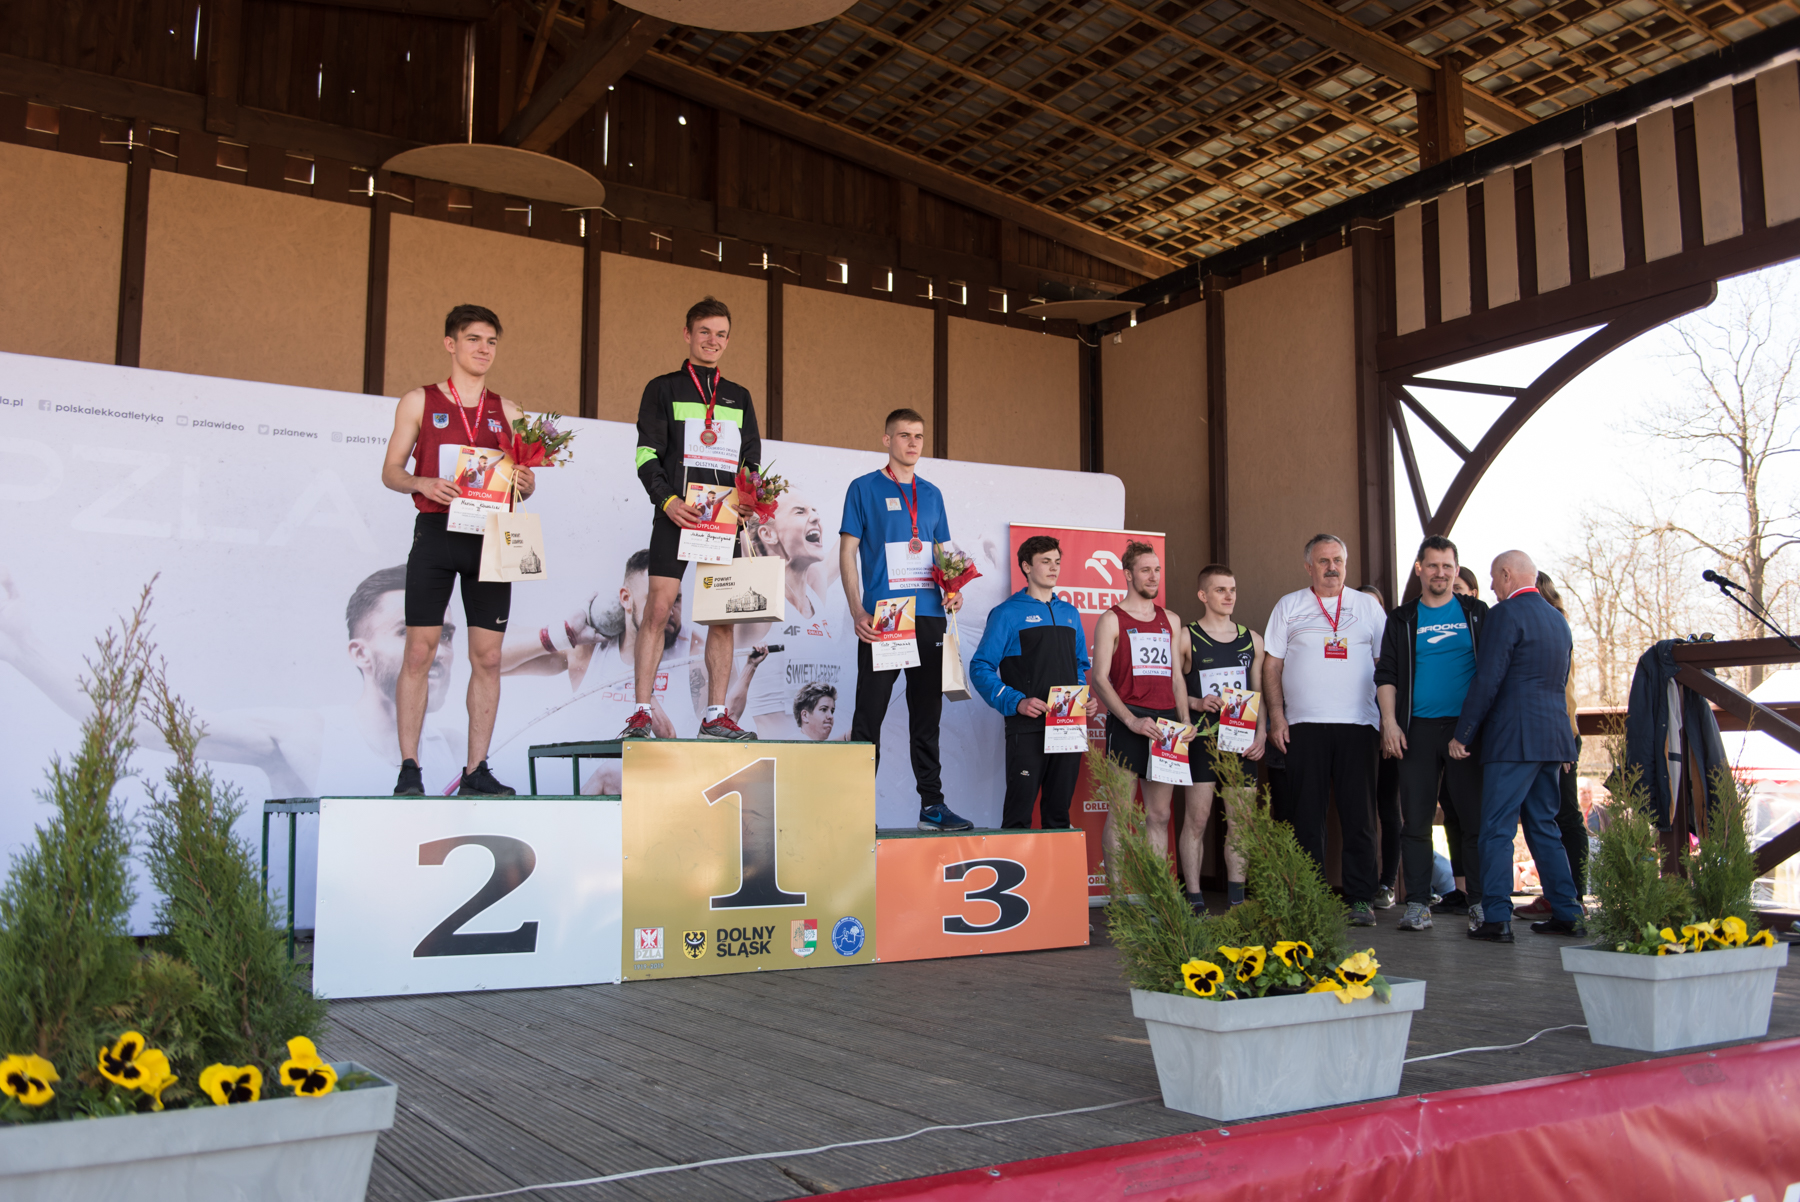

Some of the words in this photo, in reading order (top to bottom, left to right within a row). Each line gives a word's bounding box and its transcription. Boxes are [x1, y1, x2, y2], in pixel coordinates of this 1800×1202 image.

[55, 403, 164, 423] polskalekkoatletyka
[192, 418, 245, 432] pzlawideo
[272, 427, 318, 439] pzlanews
[346, 434, 387, 446] pzla1919
[467, 490, 493, 499] DYPLOM
[697, 523, 720, 531] DYPLOM
[1058, 590, 1124, 610] ORLEN
[783, 625, 801, 636] 4F
[1416, 622, 1468, 635] BROOKS
[1139, 646, 1168, 665] 326
[1087, 730, 1106, 738] RLE
[1161, 751, 1178, 760] DYPLOM
[702, 757, 807, 911] 1
[412, 833, 540, 958] 2
[942, 857, 1031, 935] 3
[716, 925, 776, 943] DOLNY
[636, 949, 662, 959] PZLA
[716, 940, 772, 958] ŚLĄSK
[633, 962, 664, 971] 1919-2019
